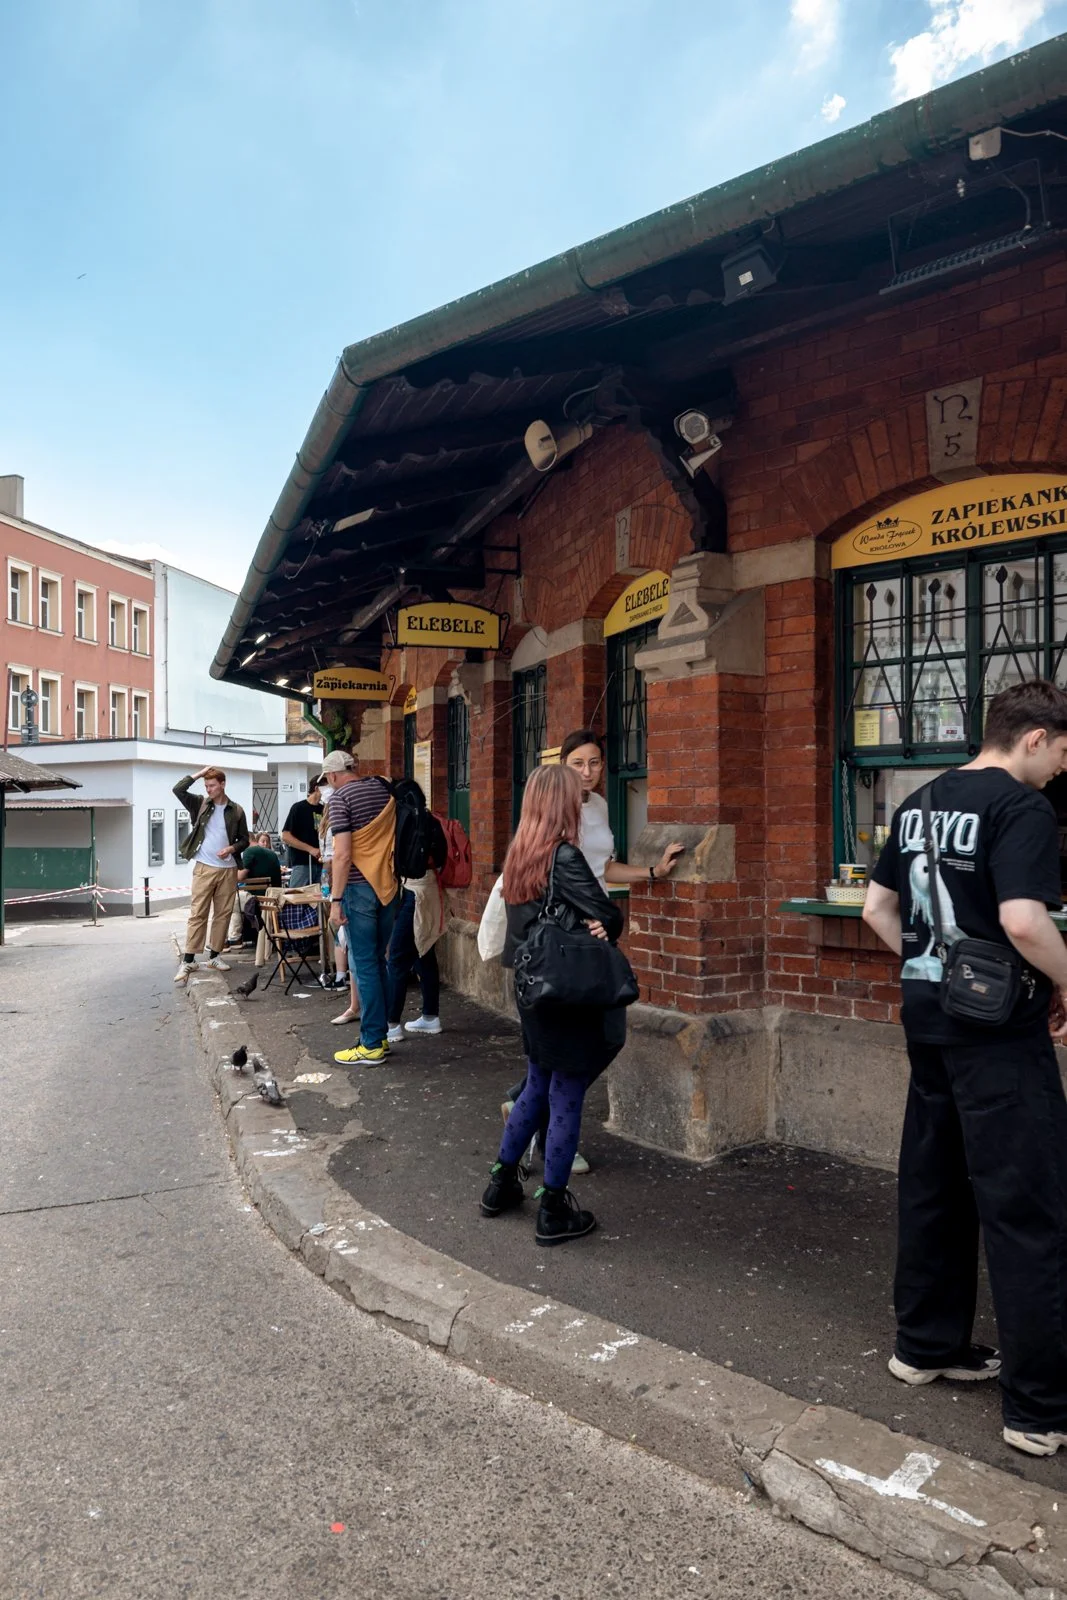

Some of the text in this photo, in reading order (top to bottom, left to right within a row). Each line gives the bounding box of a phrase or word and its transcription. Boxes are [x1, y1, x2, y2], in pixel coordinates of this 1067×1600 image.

[944, 432, 962, 457] 5
[931, 485, 1067, 525] ZAPIEKANK
[931, 508, 1066, 546] KRÓLEWSKI
[625, 578, 669, 613] ELEBELE
[407, 615, 485, 634] ELEBELE
[316, 679, 388, 691] Zapiekarnia
